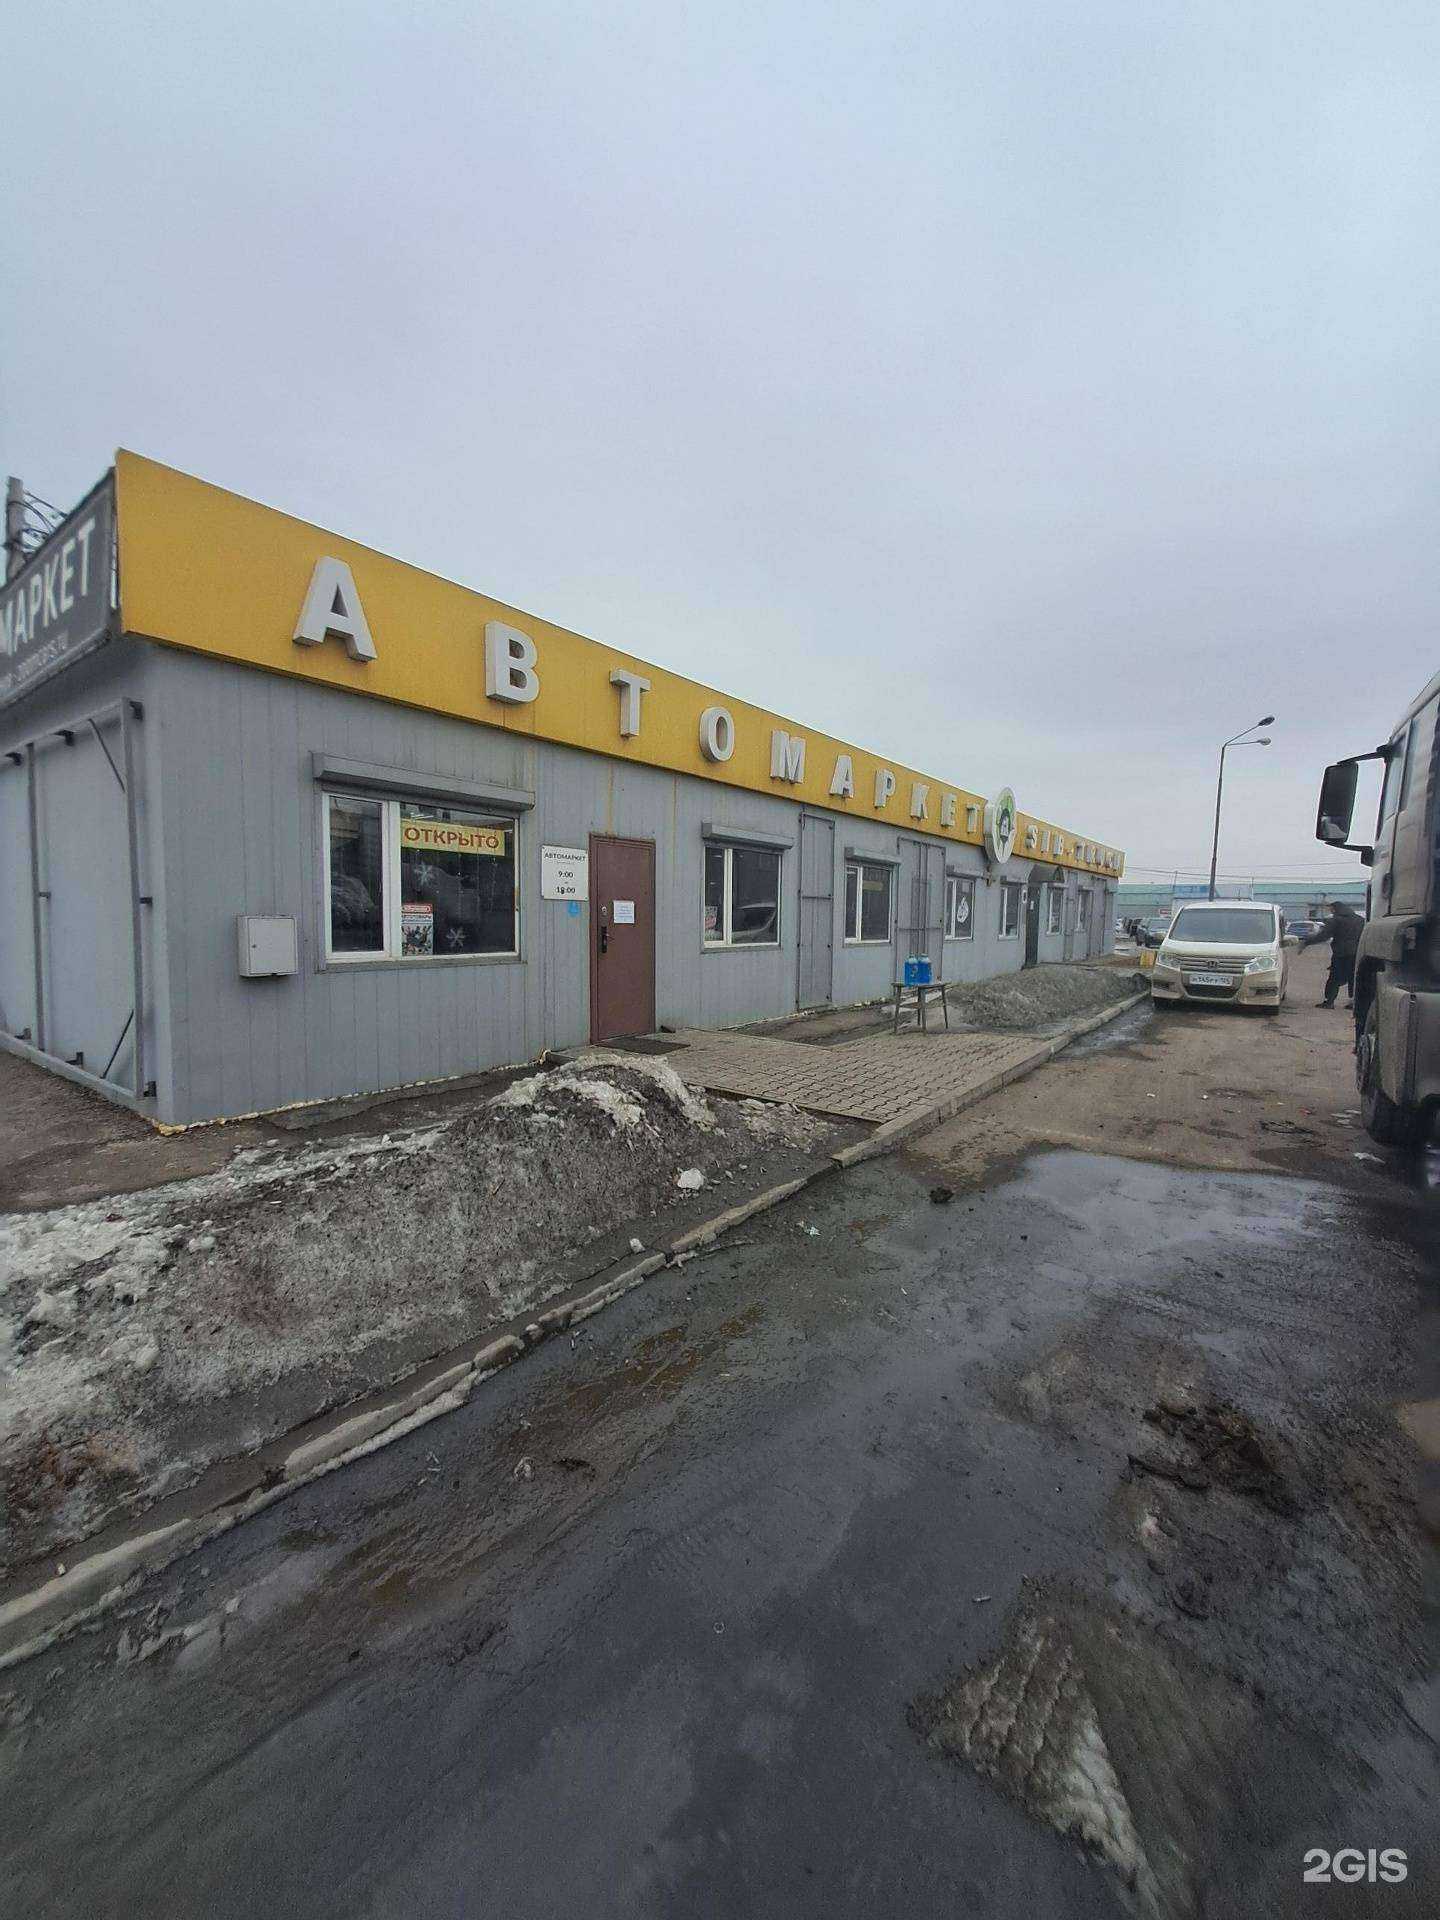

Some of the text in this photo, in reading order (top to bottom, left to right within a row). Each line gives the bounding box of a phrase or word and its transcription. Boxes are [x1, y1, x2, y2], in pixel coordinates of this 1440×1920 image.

[292, 555, 981, 834] АВТОМАРКЕТ
[404, 827, 499, 849] ОТКРЫТО
[558, 871, 574, 879] 9:00
